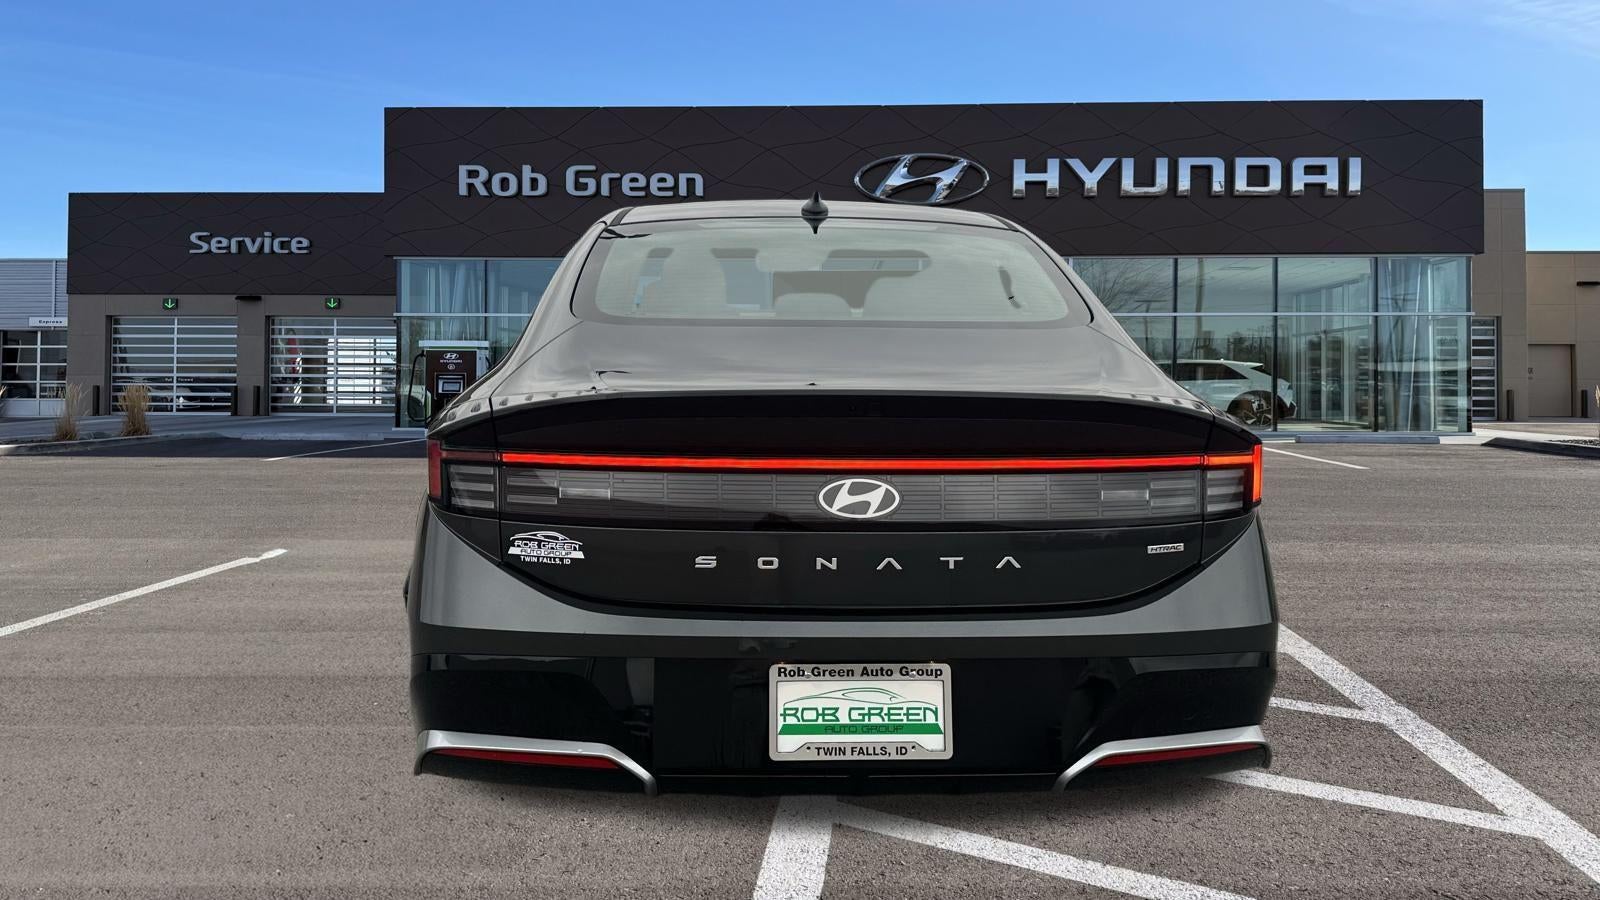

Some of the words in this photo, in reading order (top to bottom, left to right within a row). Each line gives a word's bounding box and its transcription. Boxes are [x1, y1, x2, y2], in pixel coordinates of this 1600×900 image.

[457, 163, 548, 198] Rob
[565, 164, 705, 198] Green
[1011, 156, 1362, 198] HYUNDAI
[188, 231, 311, 255] Service
[694, 555, 1022, 570] SONATA
[778, 667, 805, 677] Rob
[811, 667, 854, 677] Green
[860, 667, 893, 677] Auto
[899, 666, 942, 678] Group
[780, 707, 839, 722] ROB
[848, 707, 938, 722] GREEN
[815, 747, 848, 756] TWIN
[851, 747, 891, 757] FALLS,
[896, 747, 908, 755] ID
